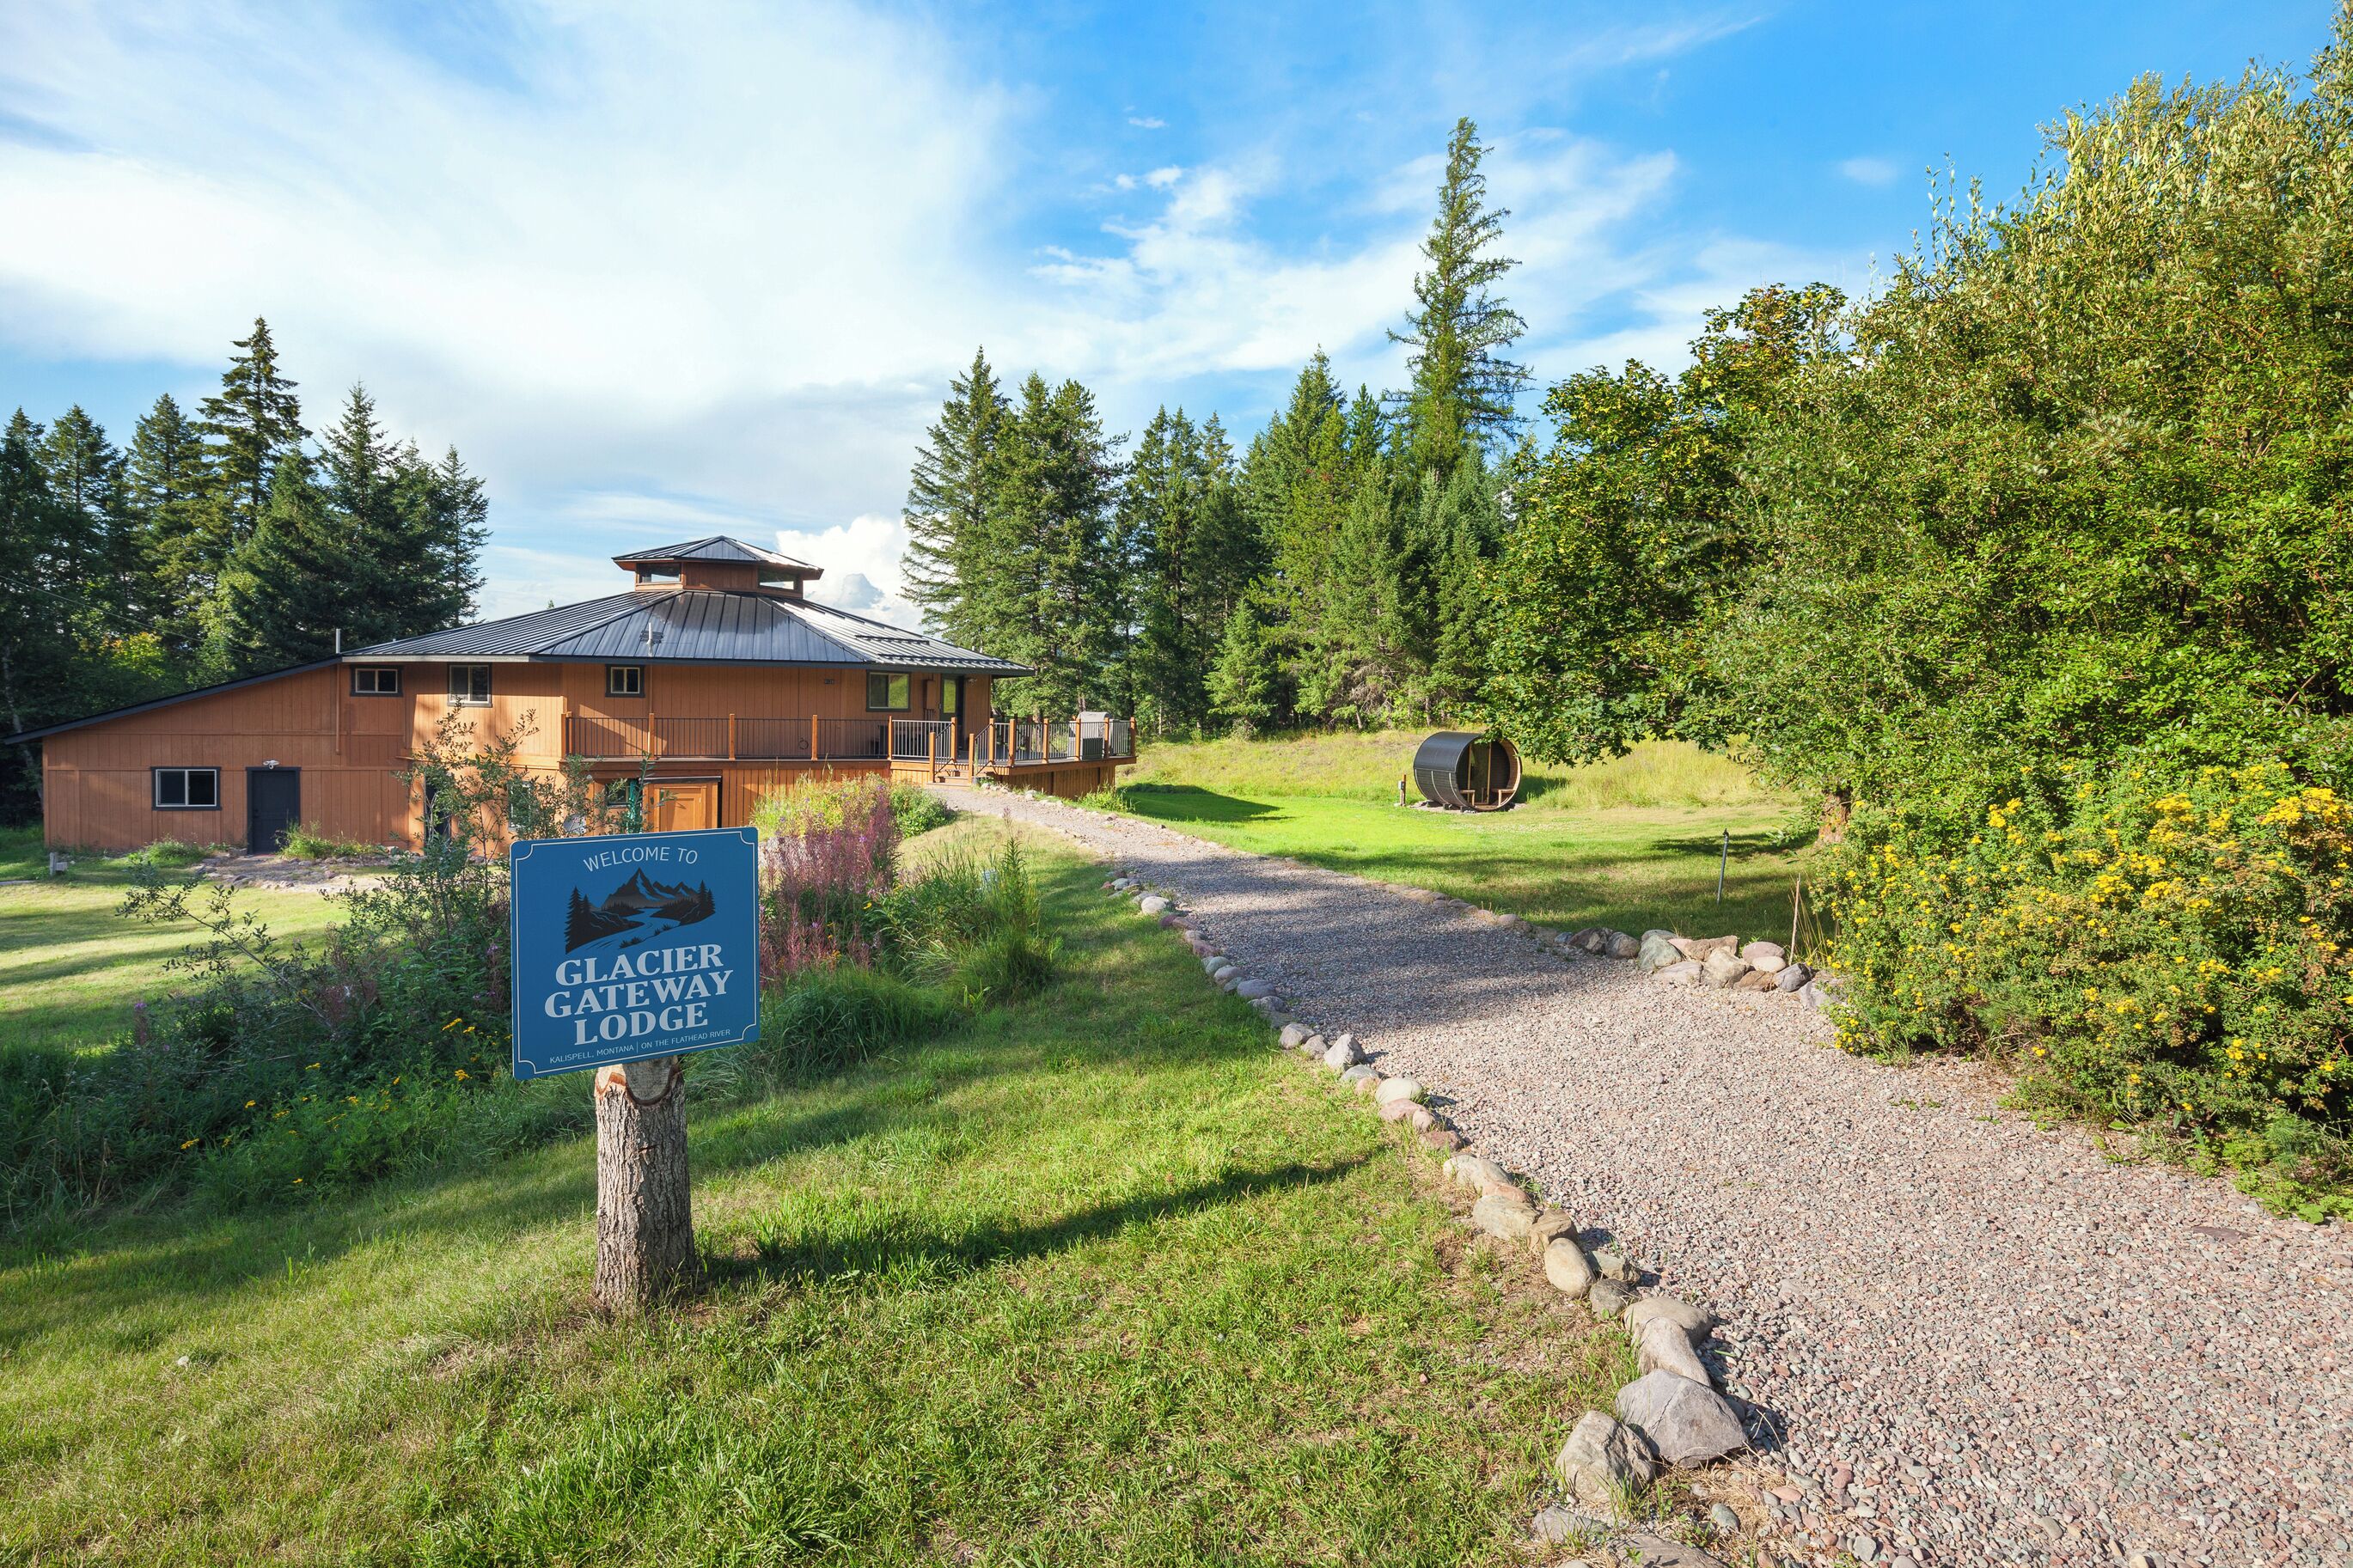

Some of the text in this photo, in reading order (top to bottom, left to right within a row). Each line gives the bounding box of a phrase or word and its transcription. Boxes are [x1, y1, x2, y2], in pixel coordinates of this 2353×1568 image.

[583, 846, 698, 872] WELCOME TO
[555, 944, 724, 986] GLACIER
[544, 970, 734, 1018] GATEWAY
[574, 1002, 708, 1046] LODGE
[596, 1044, 634, 1057] MONTANA
[655, 1038, 669, 1046] THE
[671, 1033, 708, 1045] FLATHEAD
[710, 1028, 730, 1038] RIVER
